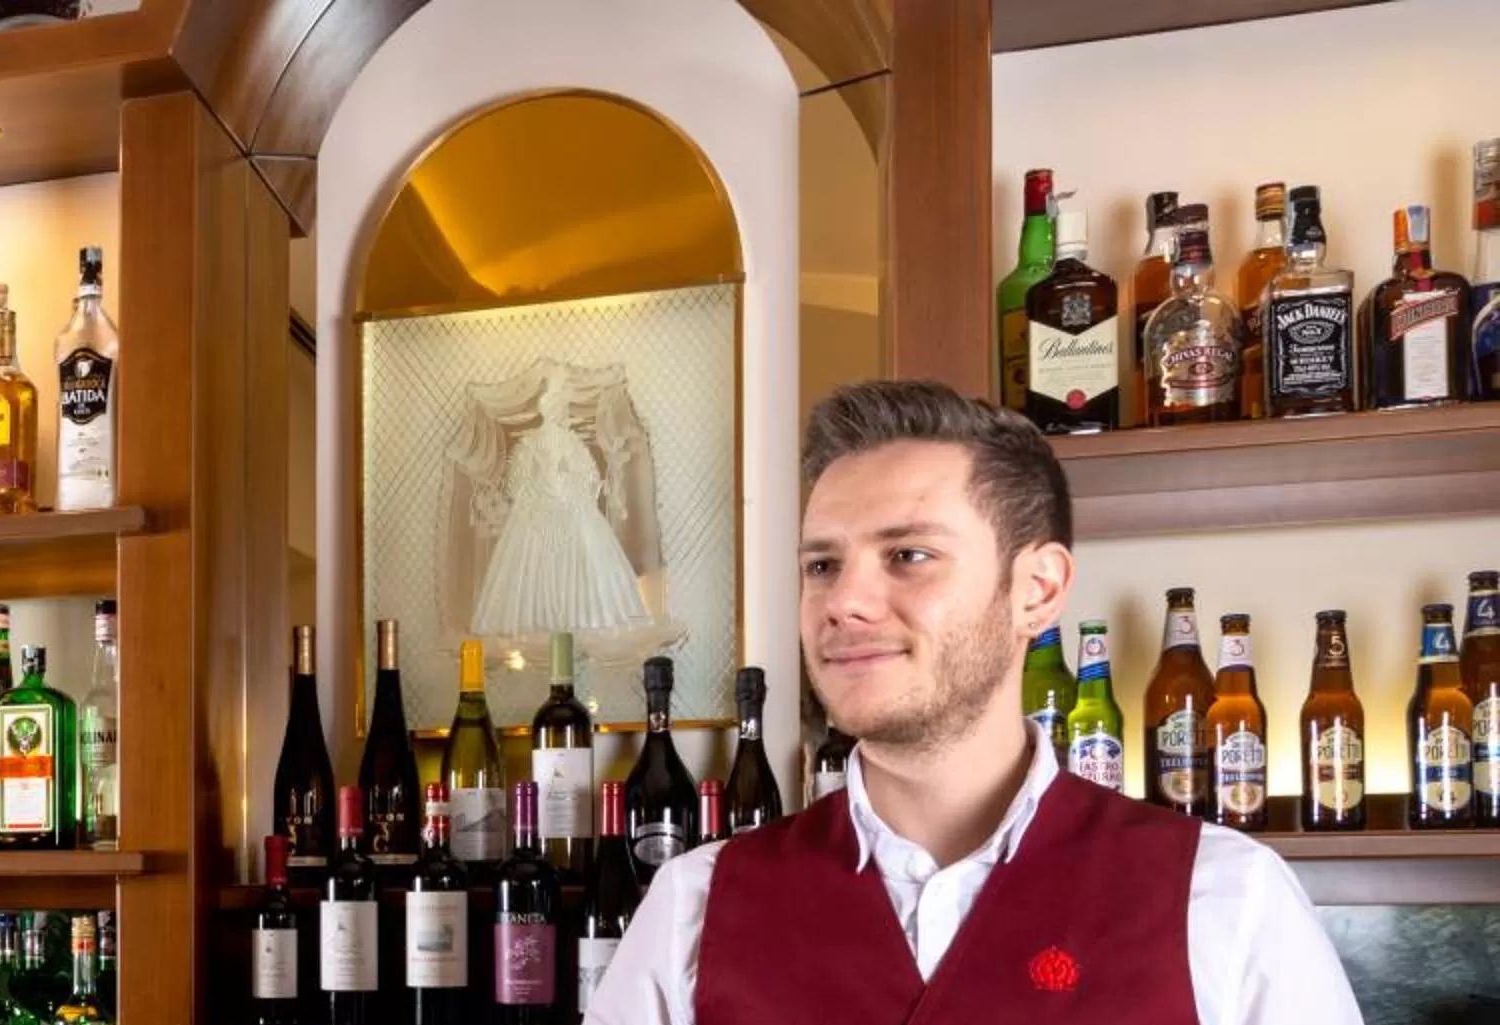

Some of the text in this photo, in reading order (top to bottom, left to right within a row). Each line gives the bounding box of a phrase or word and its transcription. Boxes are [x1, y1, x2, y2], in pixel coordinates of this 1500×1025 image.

[1476, 599, 1495, 619] 4
[1178, 616, 1192, 635] 3
[1232, 640, 1245, 656] 3
[1329, 634, 1345, 656] 5
[1434, 632, 1450, 649] 4
